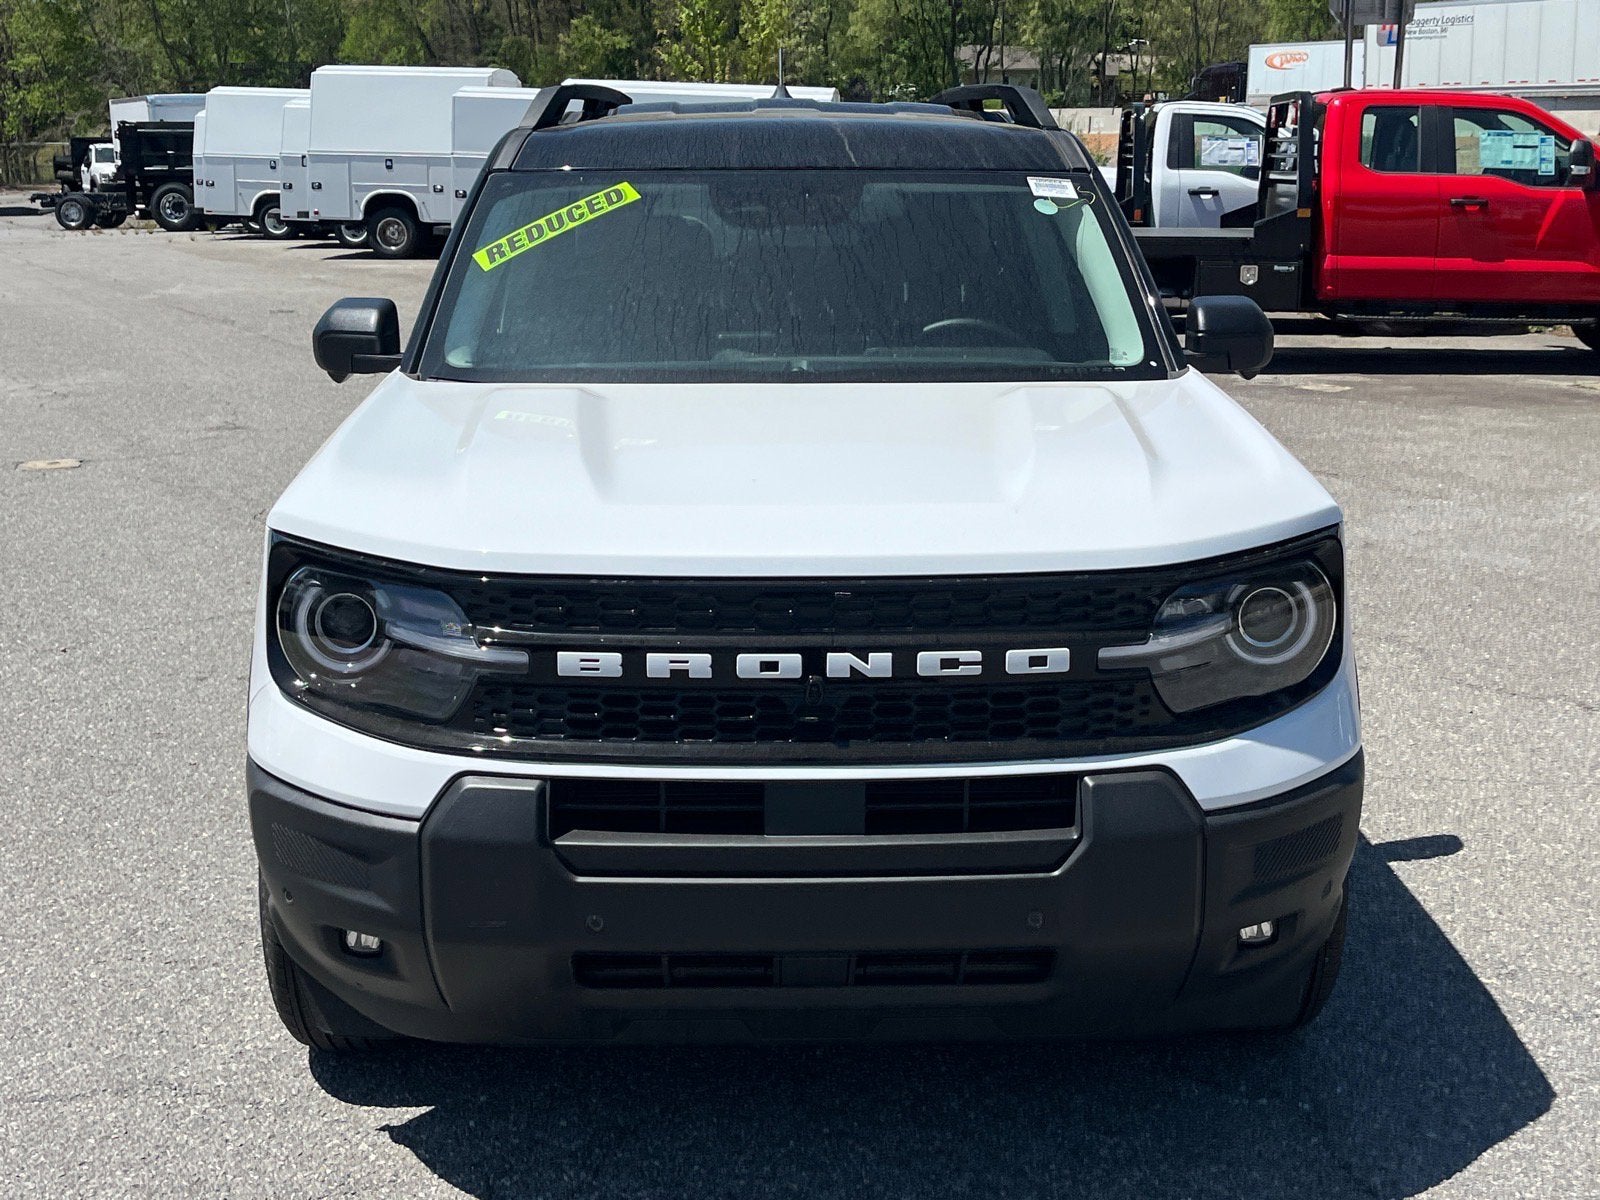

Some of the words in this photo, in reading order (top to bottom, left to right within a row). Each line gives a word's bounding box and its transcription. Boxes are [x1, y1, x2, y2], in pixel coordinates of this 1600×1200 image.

[1409, 17, 1441, 27] aggerty
[1441, 14, 1475, 26] Logistics
[486, 187, 627, 265] REDUCED
[556, 647, 1071, 679] BRONCO
